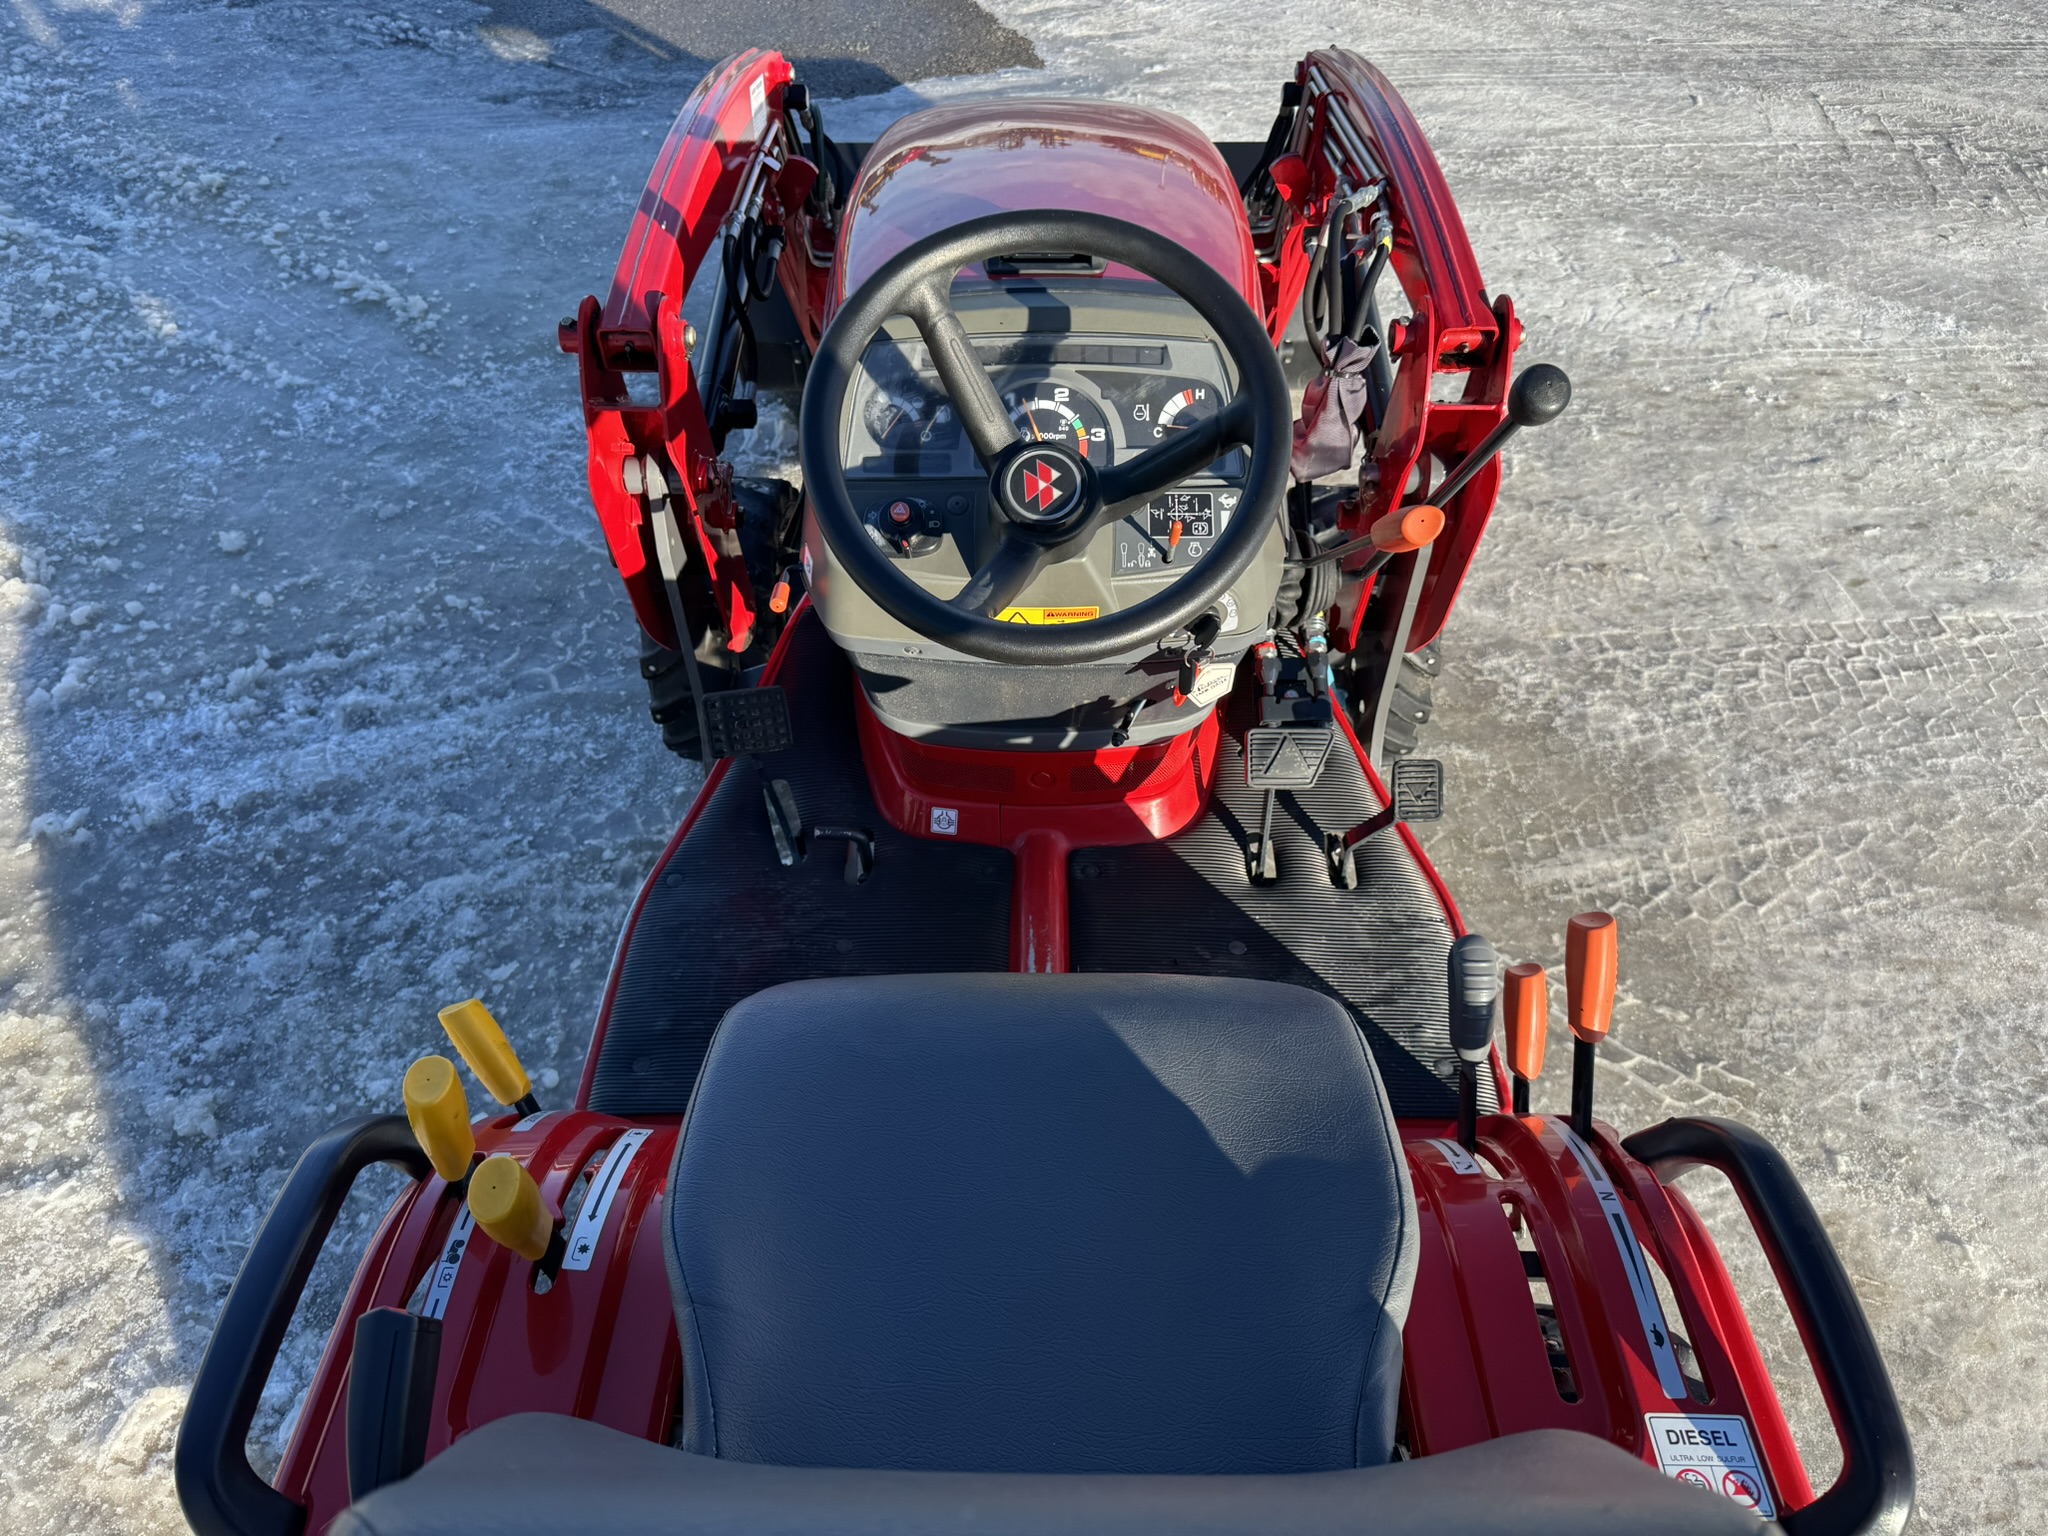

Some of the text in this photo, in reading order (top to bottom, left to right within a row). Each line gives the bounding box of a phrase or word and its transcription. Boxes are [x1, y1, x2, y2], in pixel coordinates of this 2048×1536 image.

[1053, 387, 1070, 402] 2
[1195, 388, 1206, 400] H
[1090, 427, 1106, 442] 3
[1153, 426, 1163, 438] C
[1055, 610, 1094, 618] WARNING
[1598, 1191, 1617, 1201] N
[1665, 1429, 1738, 1447] DIESEL
[1670, 1454, 1746, 1463] ULTRA LOW SULFUR
